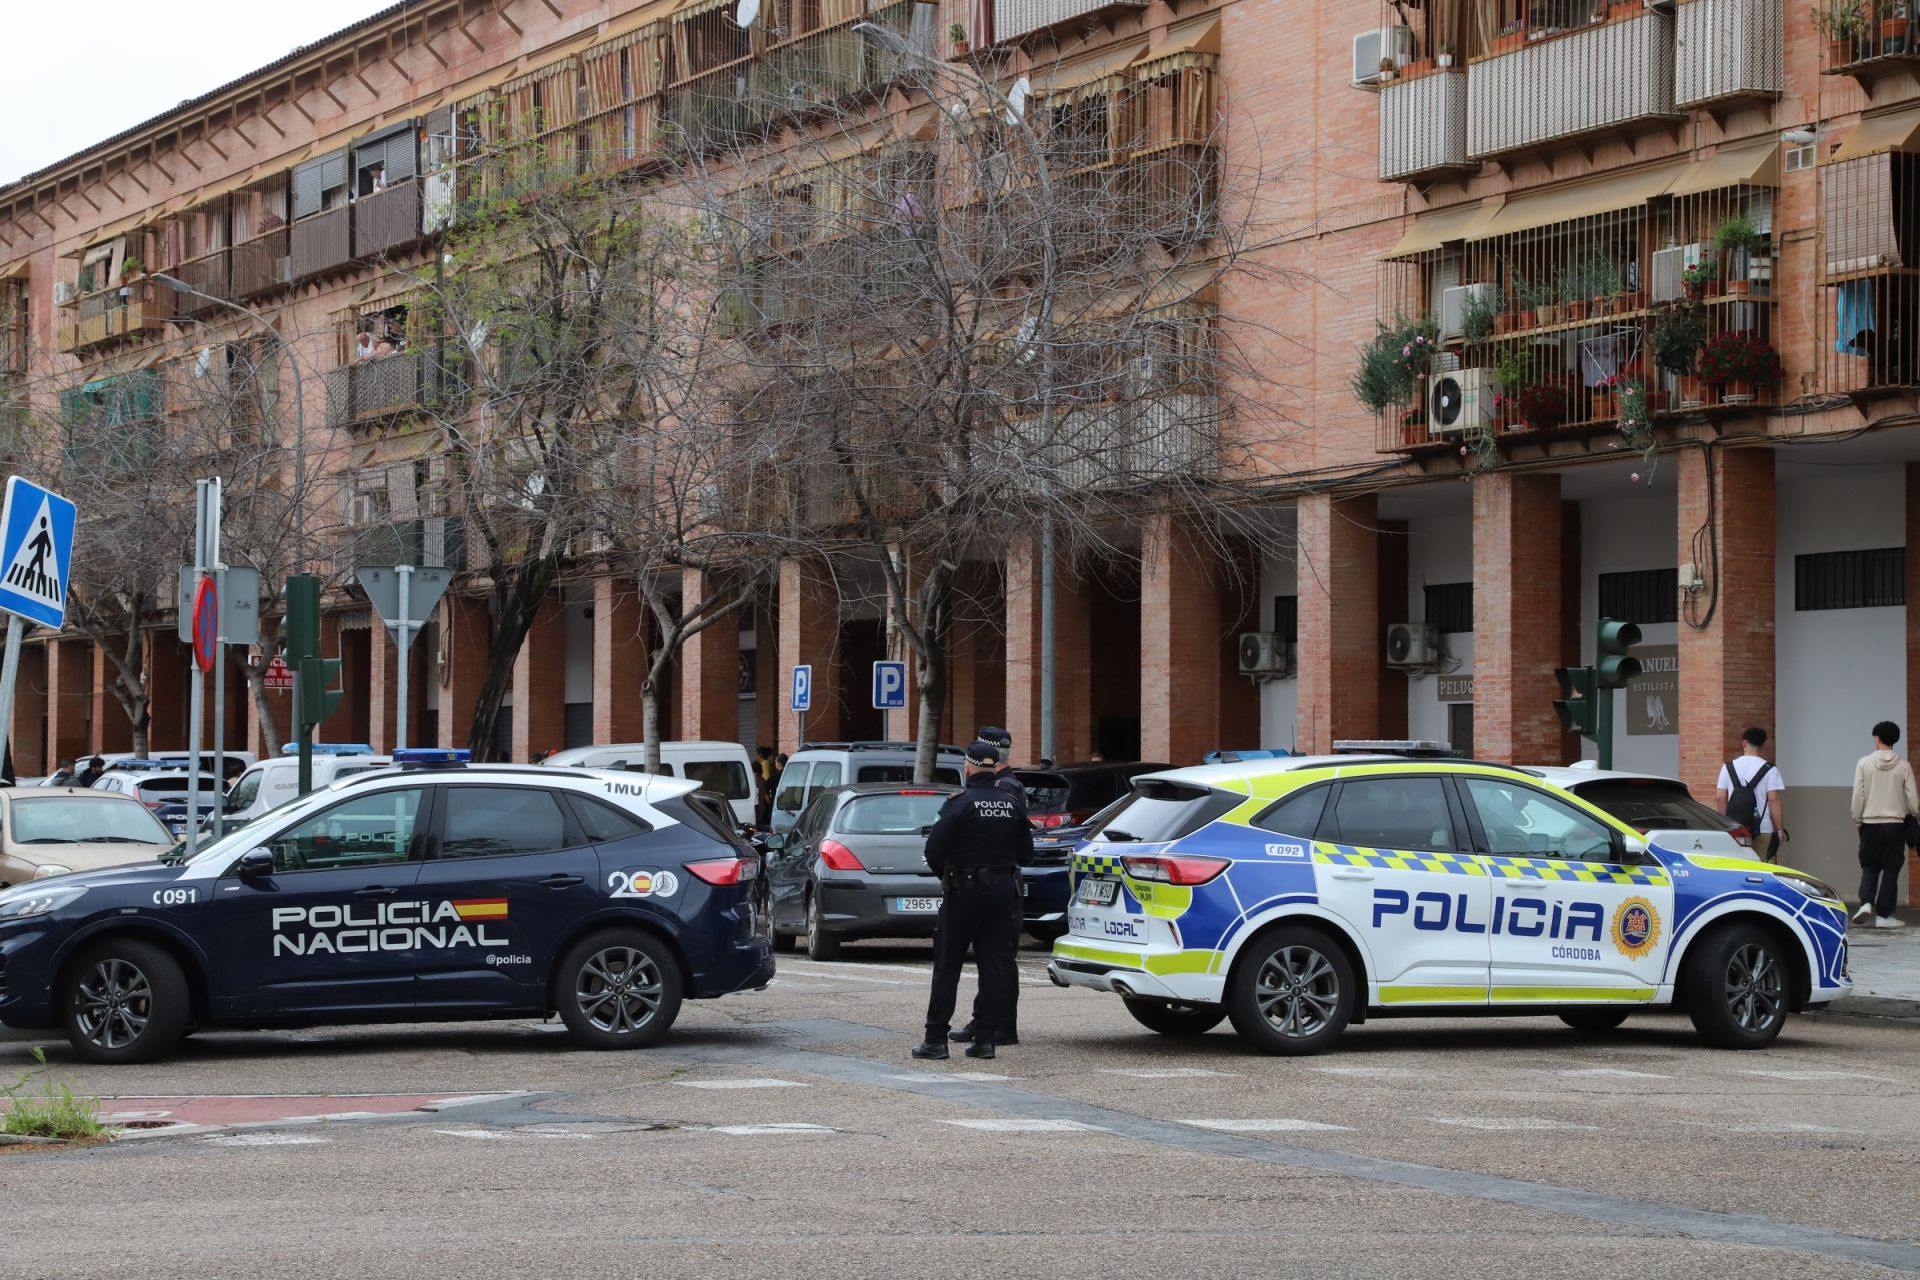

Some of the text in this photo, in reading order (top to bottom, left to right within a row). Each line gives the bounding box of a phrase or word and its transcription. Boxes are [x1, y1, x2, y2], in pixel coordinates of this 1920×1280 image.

[1639, 656, 1679, 673] ANUEL
[795, 670, 807, 707] P
[880, 666, 901, 704] P
[1633, 682, 1676, 692] ESTILISTA
[604, 782, 643, 797] 1MU
[974, 801, 1014, 810] POLICIA
[980, 809, 1012, 818] LOCAL
[1277, 846, 1300, 856] 092
[608, 871, 679, 898] 200
[163, 889, 196, 905] 091
[904, 898, 933, 910] 2965
[1105, 921, 1138, 936] LOCAL
[273, 924, 509, 956] NACIONAL
[485, 953, 532, 966] @policia
[1551, 945, 1602, 961] CÓRDOBA
